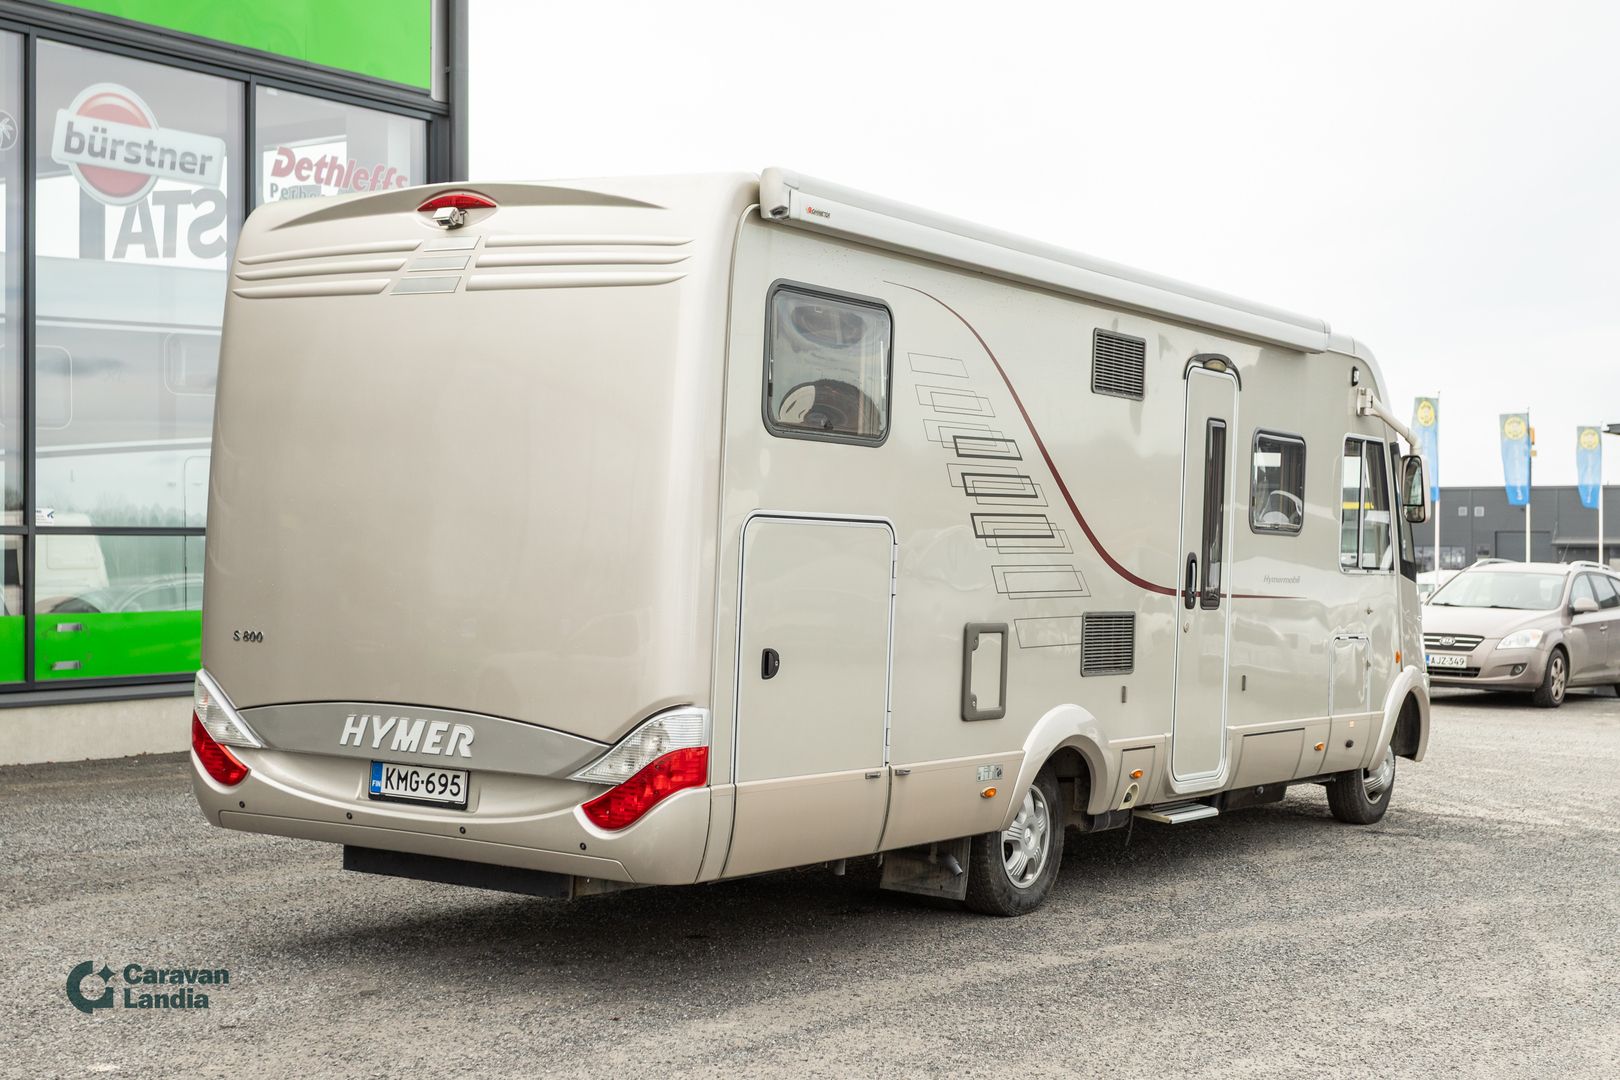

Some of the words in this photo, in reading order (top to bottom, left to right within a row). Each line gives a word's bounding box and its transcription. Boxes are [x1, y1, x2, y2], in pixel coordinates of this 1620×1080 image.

[64, 121, 213, 176] bürstner
[271, 146, 408, 191] Dethleffs
[233, 630, 240, 642] S
[242, 631, 263, 643] 800
[1431, 656, 1464, 666] AJZ-349
[339, 714, 475, 758] HYMER
[385, 767, 461, 797] KMG-695
